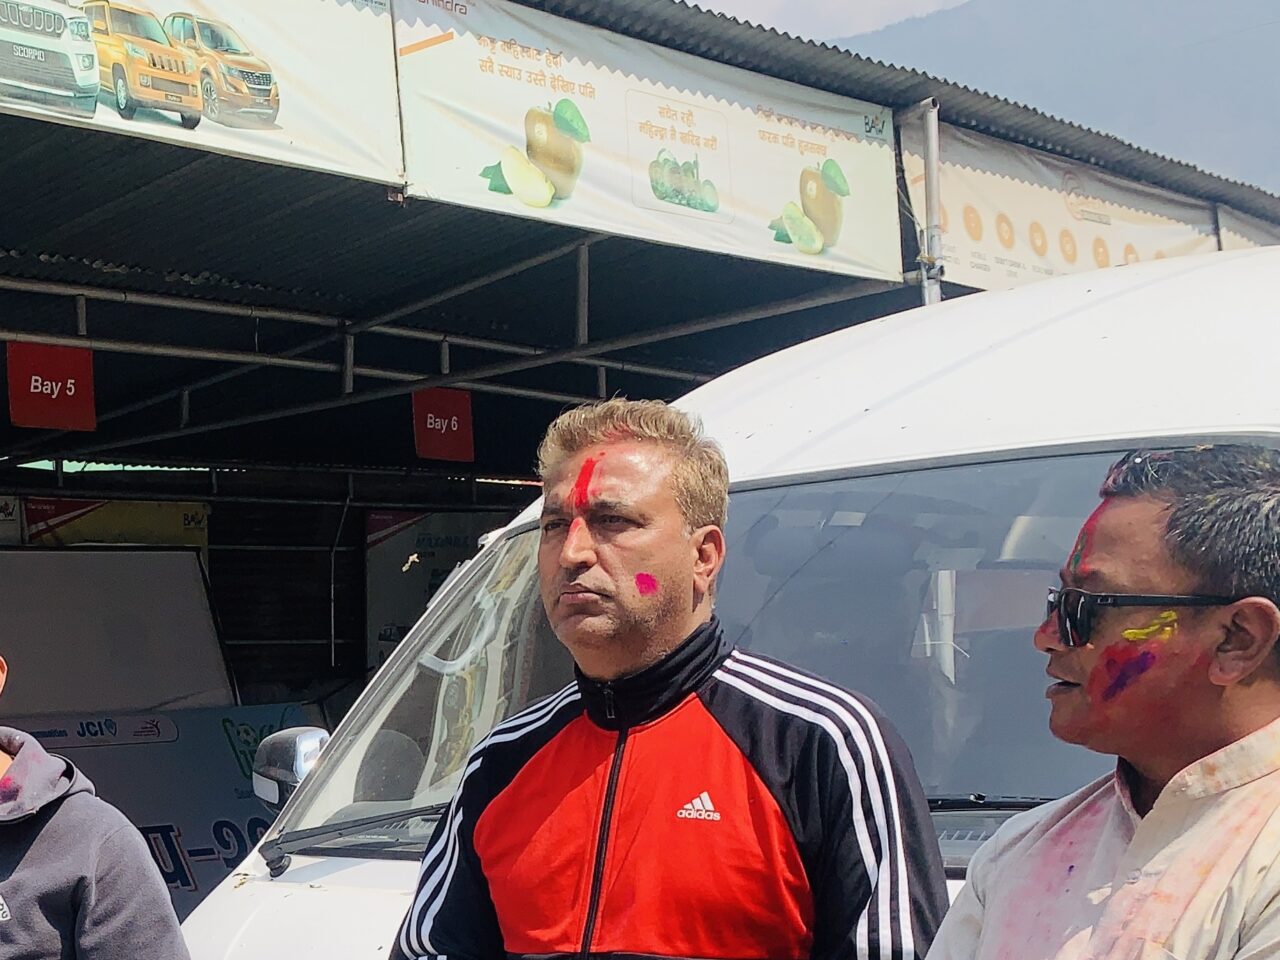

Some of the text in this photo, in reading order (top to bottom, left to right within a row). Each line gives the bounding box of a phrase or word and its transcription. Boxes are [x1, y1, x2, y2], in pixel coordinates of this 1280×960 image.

[13, 44, 45, 62] SCORPIO
[29, 375, 76, 397] Bay 5
[426, 413, 459, 432] Bay 6
[77, 720, 105, 738] JCI
[676, 809, 721, 821] adidas
